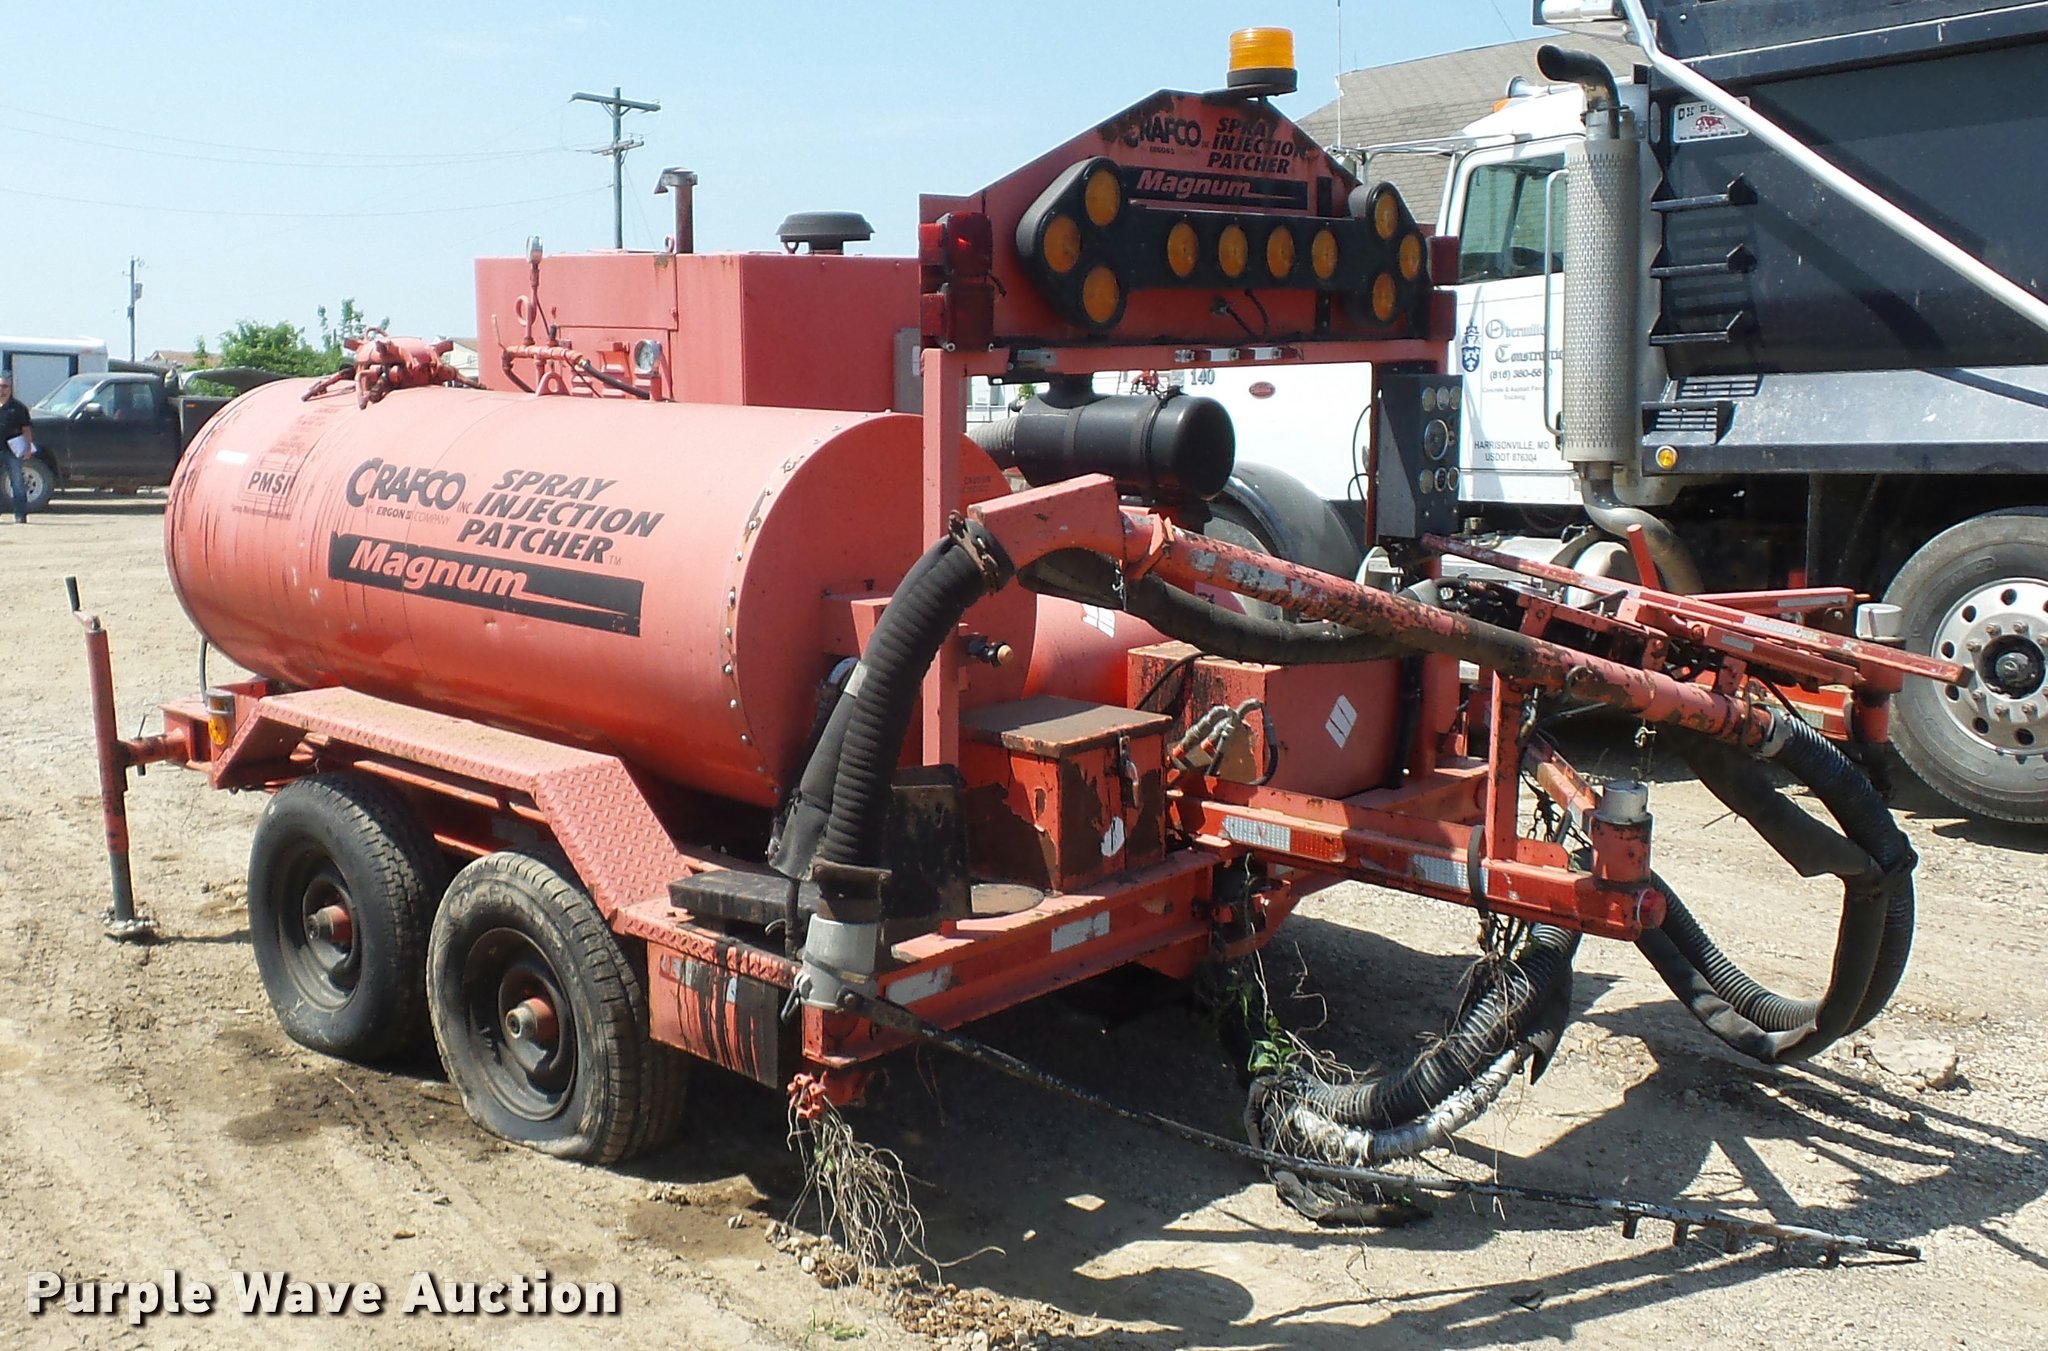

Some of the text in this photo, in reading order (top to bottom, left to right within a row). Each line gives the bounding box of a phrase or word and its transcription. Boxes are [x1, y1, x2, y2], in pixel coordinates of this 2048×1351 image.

[1207, 151, 1290, 174] PATCHER
[1137, 169, 1251, 199] Magnum
[1190, 368, 1215, 385] 140
[1485, 453, 1510, 461] USDOT
[1537, 441, 1550, 450] MO
[247, 471, 291, 495] PMSI
[346, 457, 466, 511] CRAFCO
[492, 469, 618, 501] SPRAY
[376, 506, 407, 520] ERGON
[473, 491, 665, 538] INJECTION
[457, 518, 614, 565] PATCHER
[348, 539, 528, 597] Magnum
